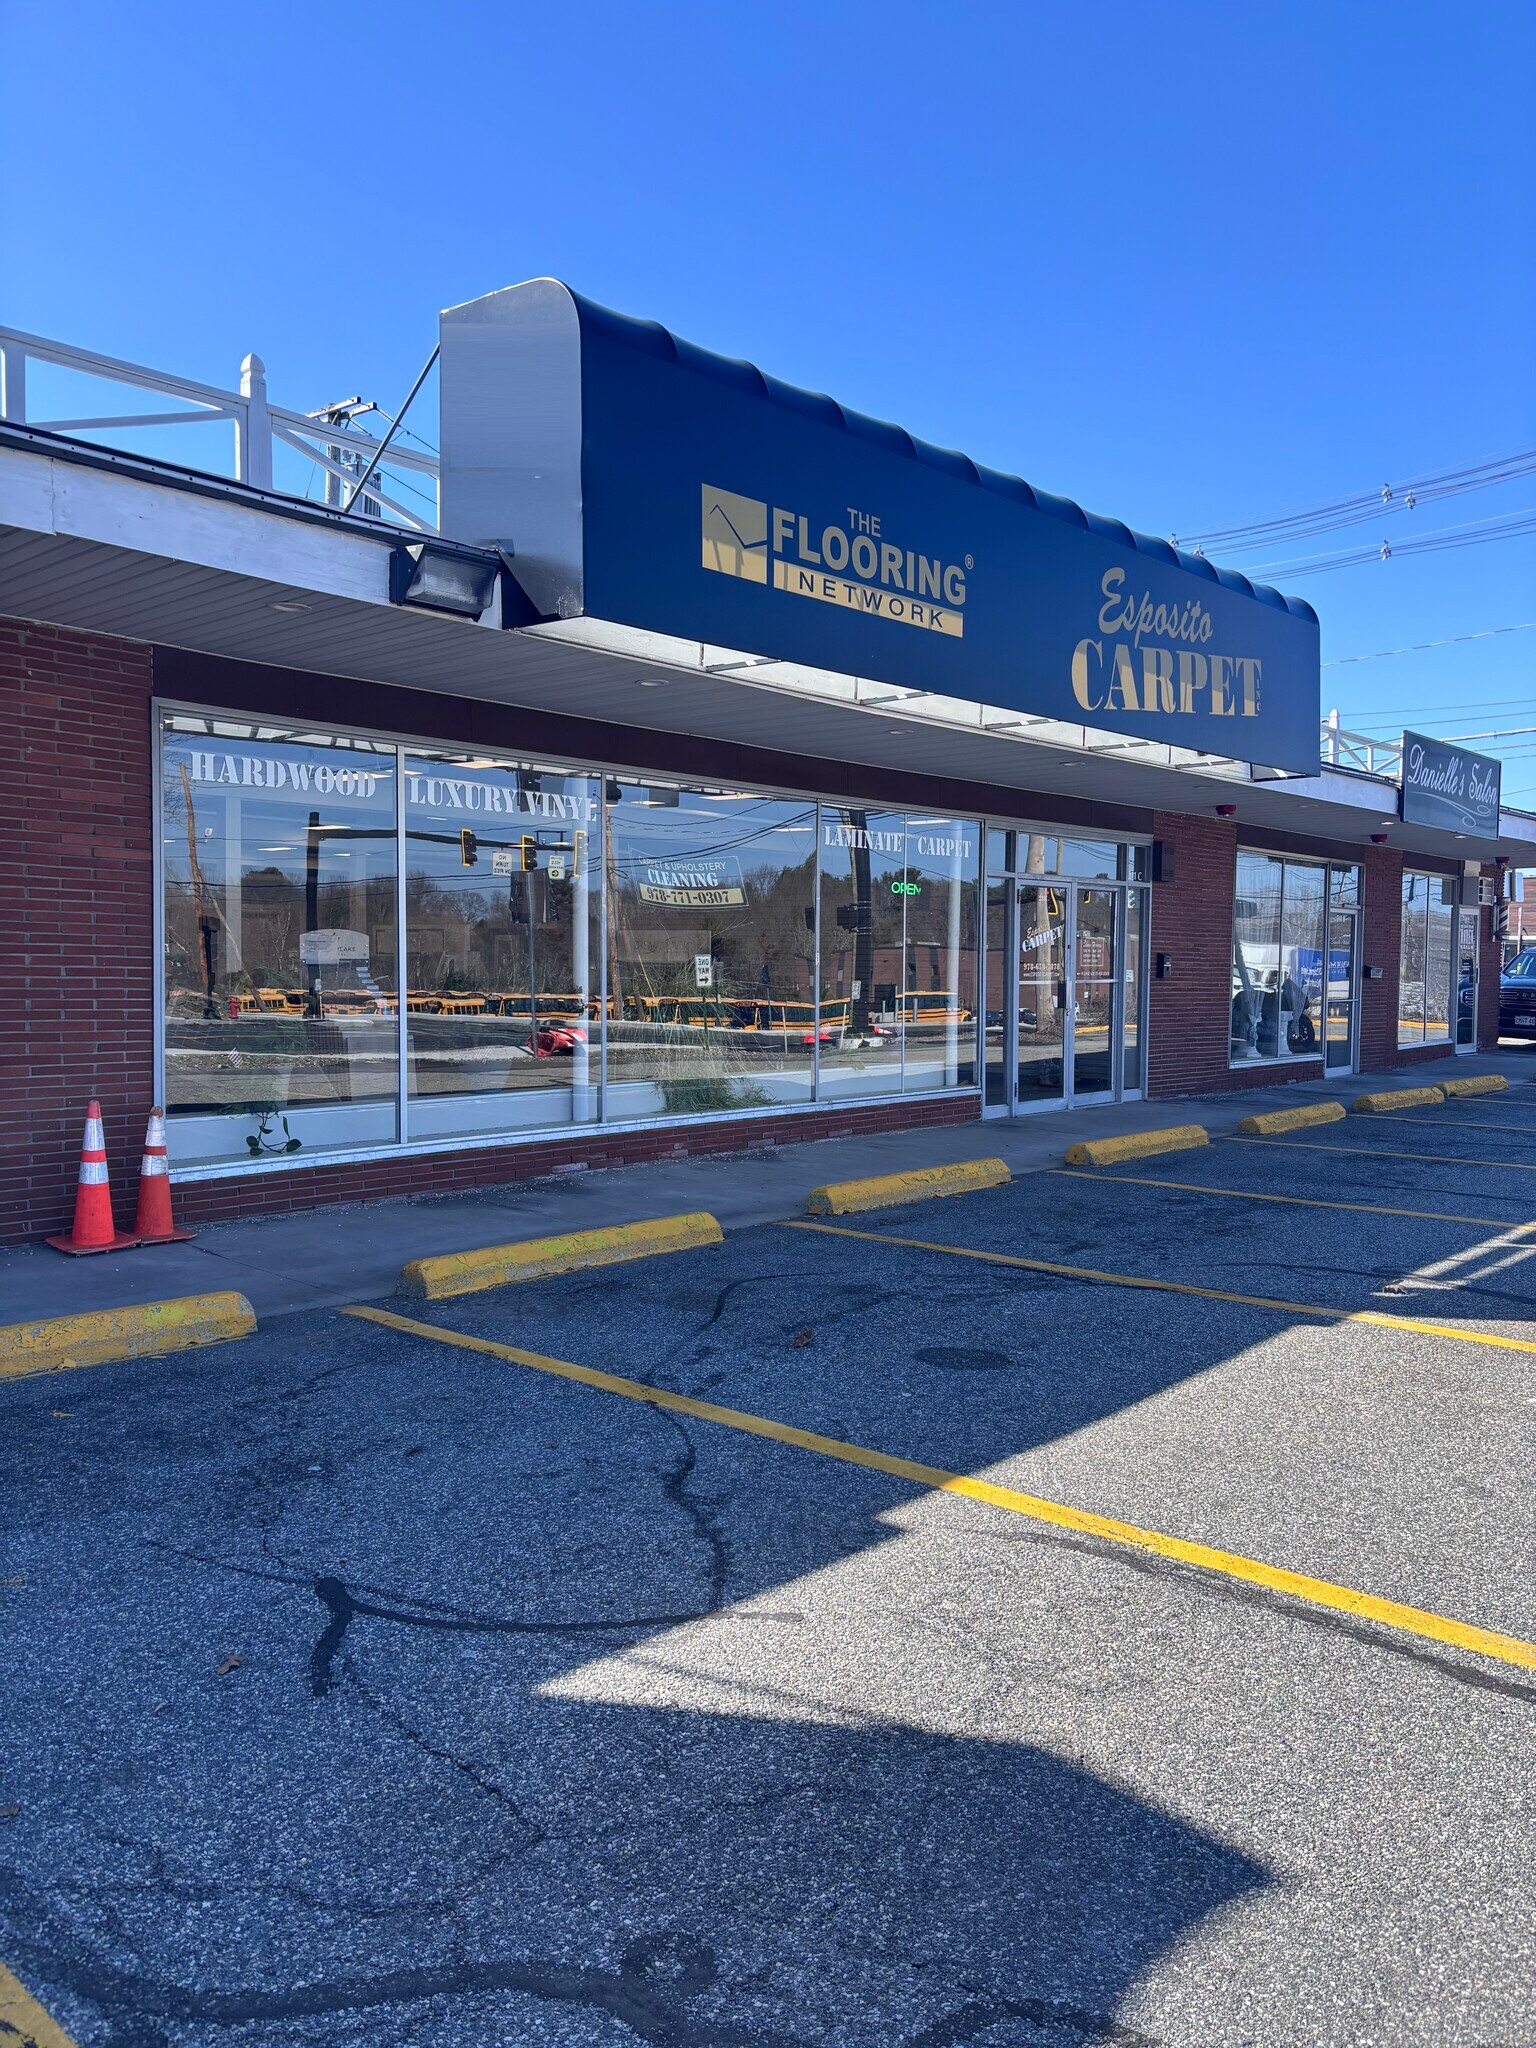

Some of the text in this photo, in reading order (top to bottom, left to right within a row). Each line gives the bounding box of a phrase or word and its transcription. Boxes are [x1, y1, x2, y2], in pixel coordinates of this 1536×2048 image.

[847, 507, 881, 538] THE
[773, 506, 966, 606] FLOORING
[799, 571, 943, 628] NETWORK
[1098, 567, 1213, 648] Esposito
[1071, 638, 1262, 717] CARPET
[190, 751, 376, 798] HARDWOOD
[1407, 743, 1498, 804] Danielle's Salon
[409, 777, 597, 822] LUXURY VINYL
[824, 826, 971, 858] LAMINATE CARPET
[647, 868, 719, 888] CLEANING
[671, 861, 726, 871] UPHOLSTERY
[647, 886, 729, 904] 978-771-0307
[891, 881, 922, 896] OPEN
[1022, 924, 1065, 952] CARPET
